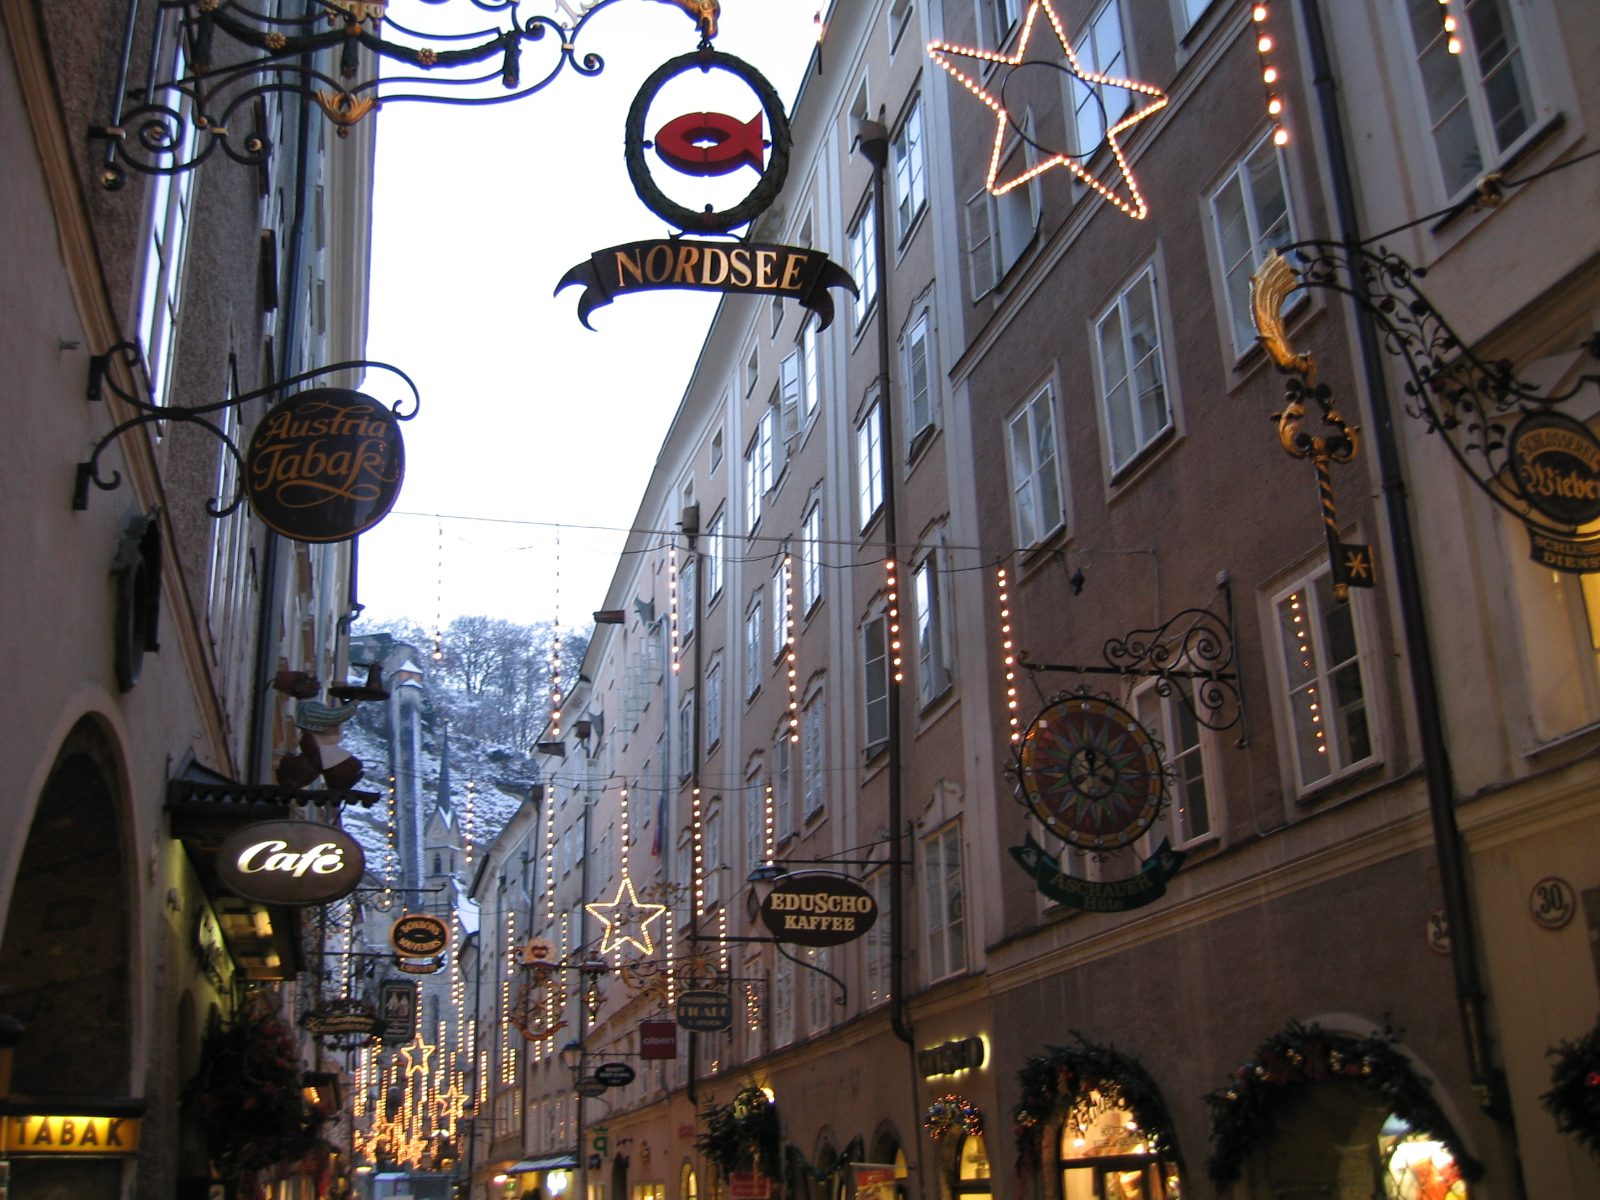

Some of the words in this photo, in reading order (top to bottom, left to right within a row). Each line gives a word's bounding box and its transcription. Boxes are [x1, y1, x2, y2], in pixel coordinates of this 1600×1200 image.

[614, 243, 809, 290] NORDSEE
[256, 402, 389, 449] Austria
[253, 439, 397, 507] Tabak
[237, 840, 345, 878] Café
[1050, 871, 1156, 898] ASCHAUER
[1537, 883, 1563, 912] 30
[769, 892, 873, 914] EDUSCHO
[1083, 896, 1127, 911] Hüte
[784, 915, 856, 931] KAFFEE
[15, 1117, 125, 1146] TABAK
